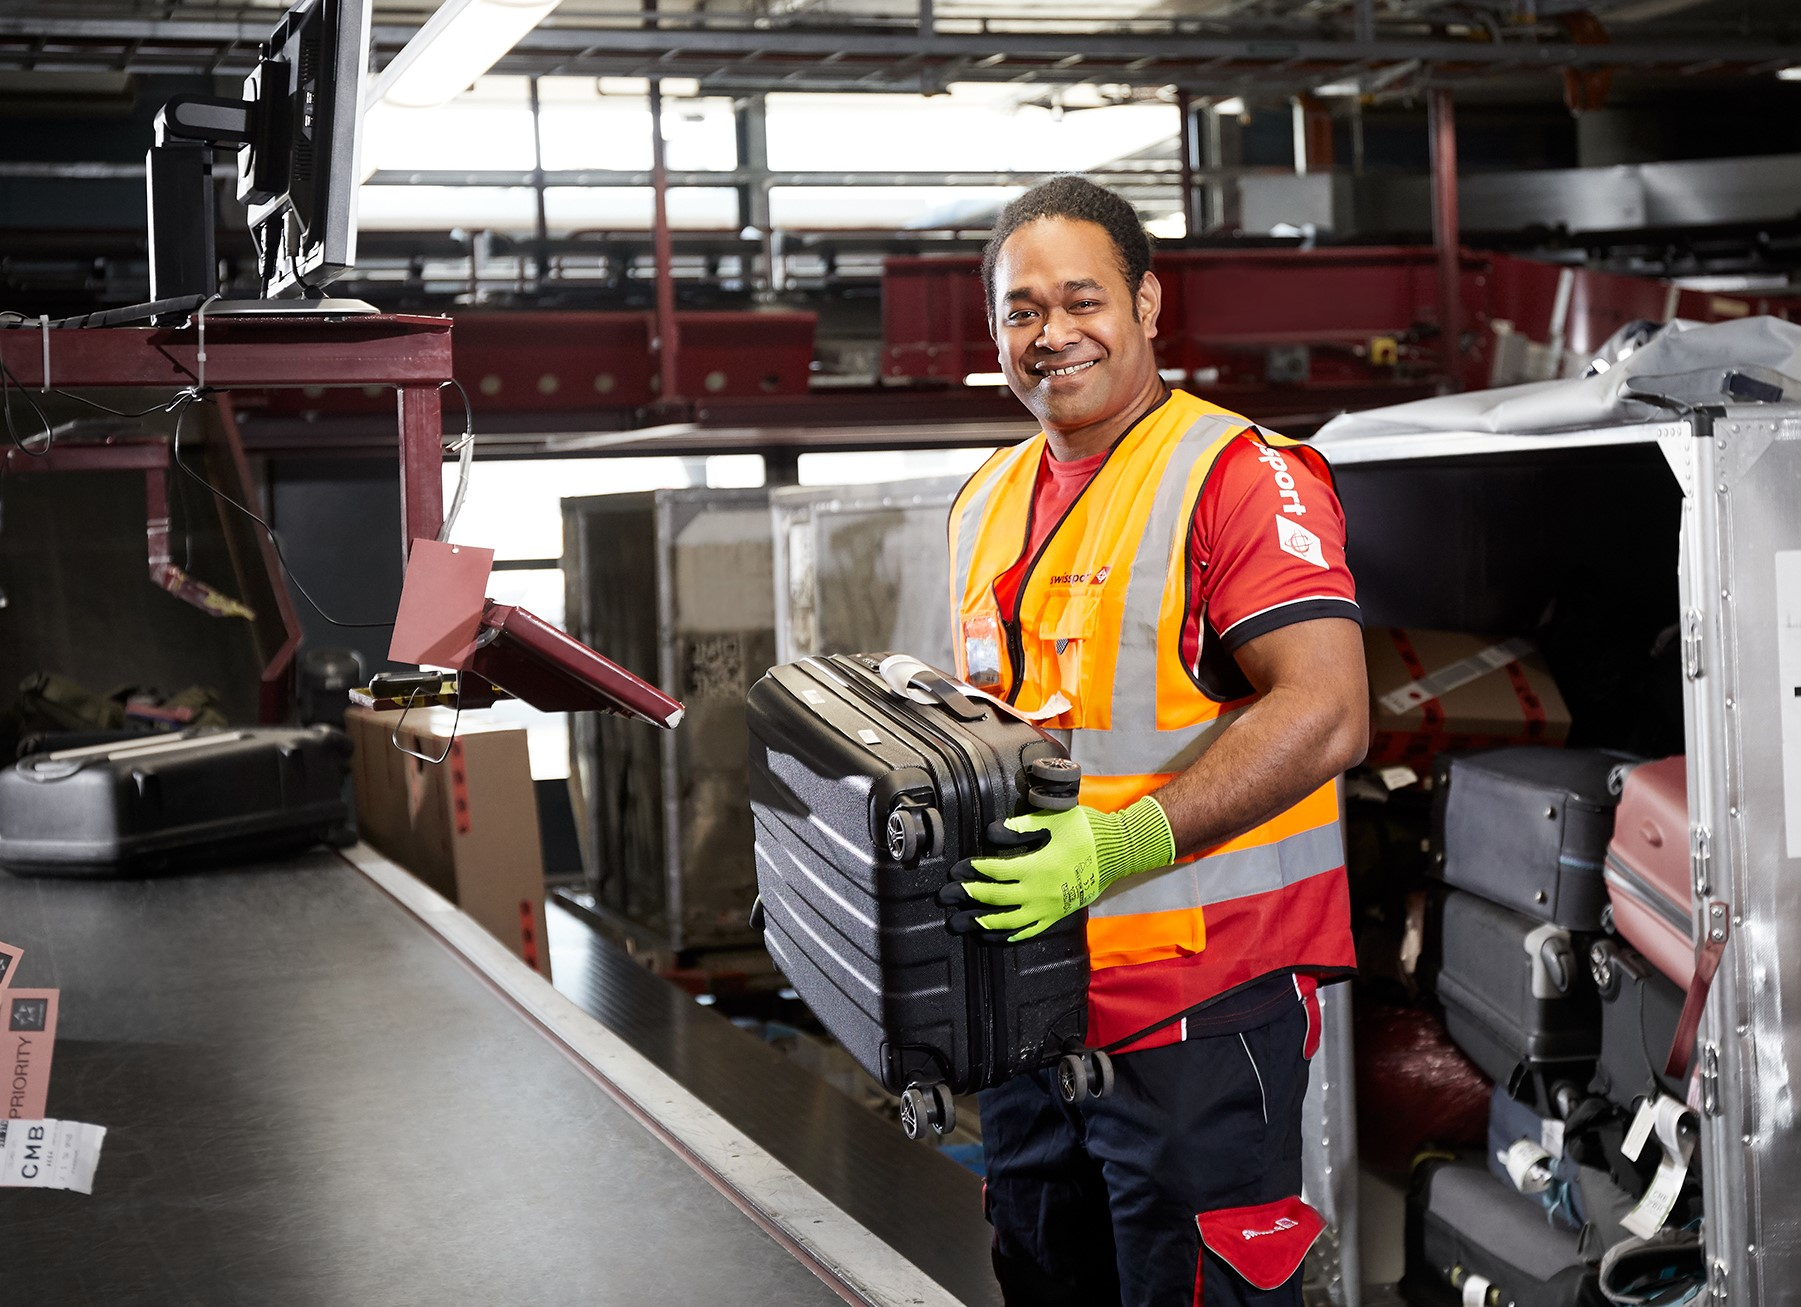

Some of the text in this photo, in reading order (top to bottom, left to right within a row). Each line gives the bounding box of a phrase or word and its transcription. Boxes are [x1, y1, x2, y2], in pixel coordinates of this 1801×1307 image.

[1050, 571, 1092, 585] swisspo
[9, 1036, 33, 1119] PRIORITY
[21, 1125, 45, 1180] CMB
